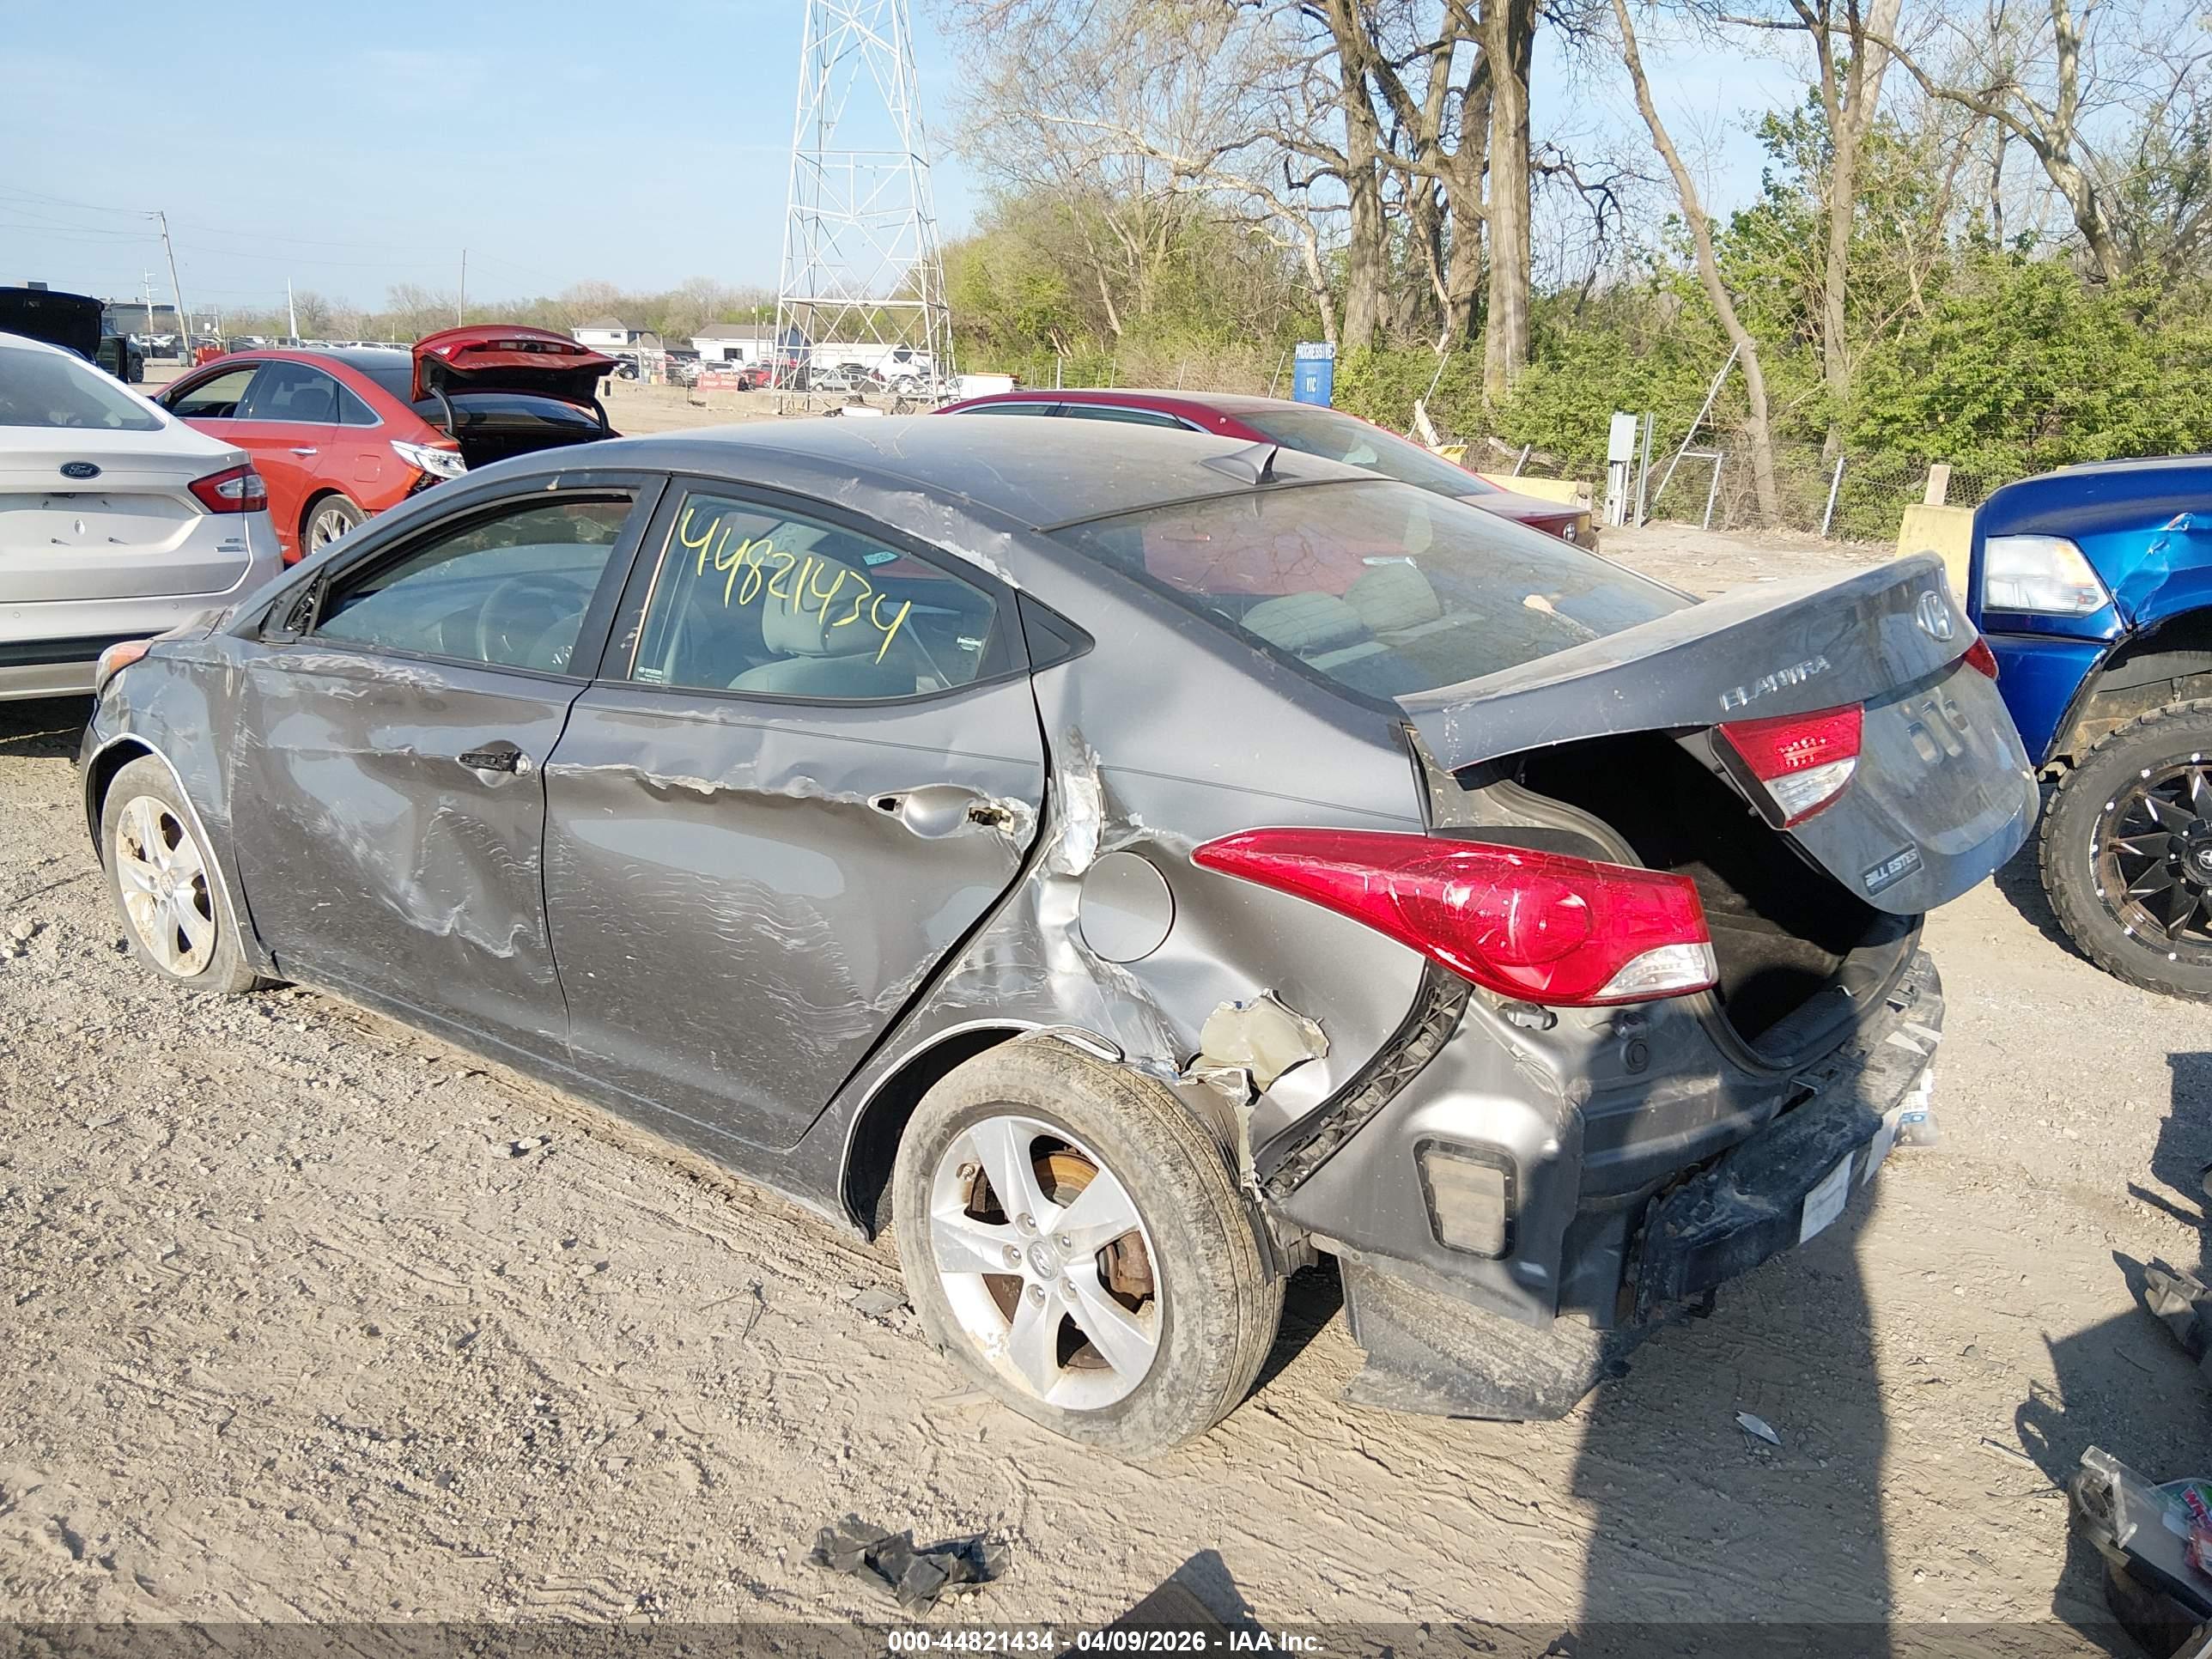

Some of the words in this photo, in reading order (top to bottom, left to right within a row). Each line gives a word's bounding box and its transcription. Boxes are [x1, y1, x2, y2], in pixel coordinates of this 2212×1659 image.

[1295, 343, 1333, 359] PROGRESSIVE
[680, 507, 911, 665] 44821434
[1718, 655, 1832, 712] ELANTRA
[1887, 848, 1917, 874] ESTES
